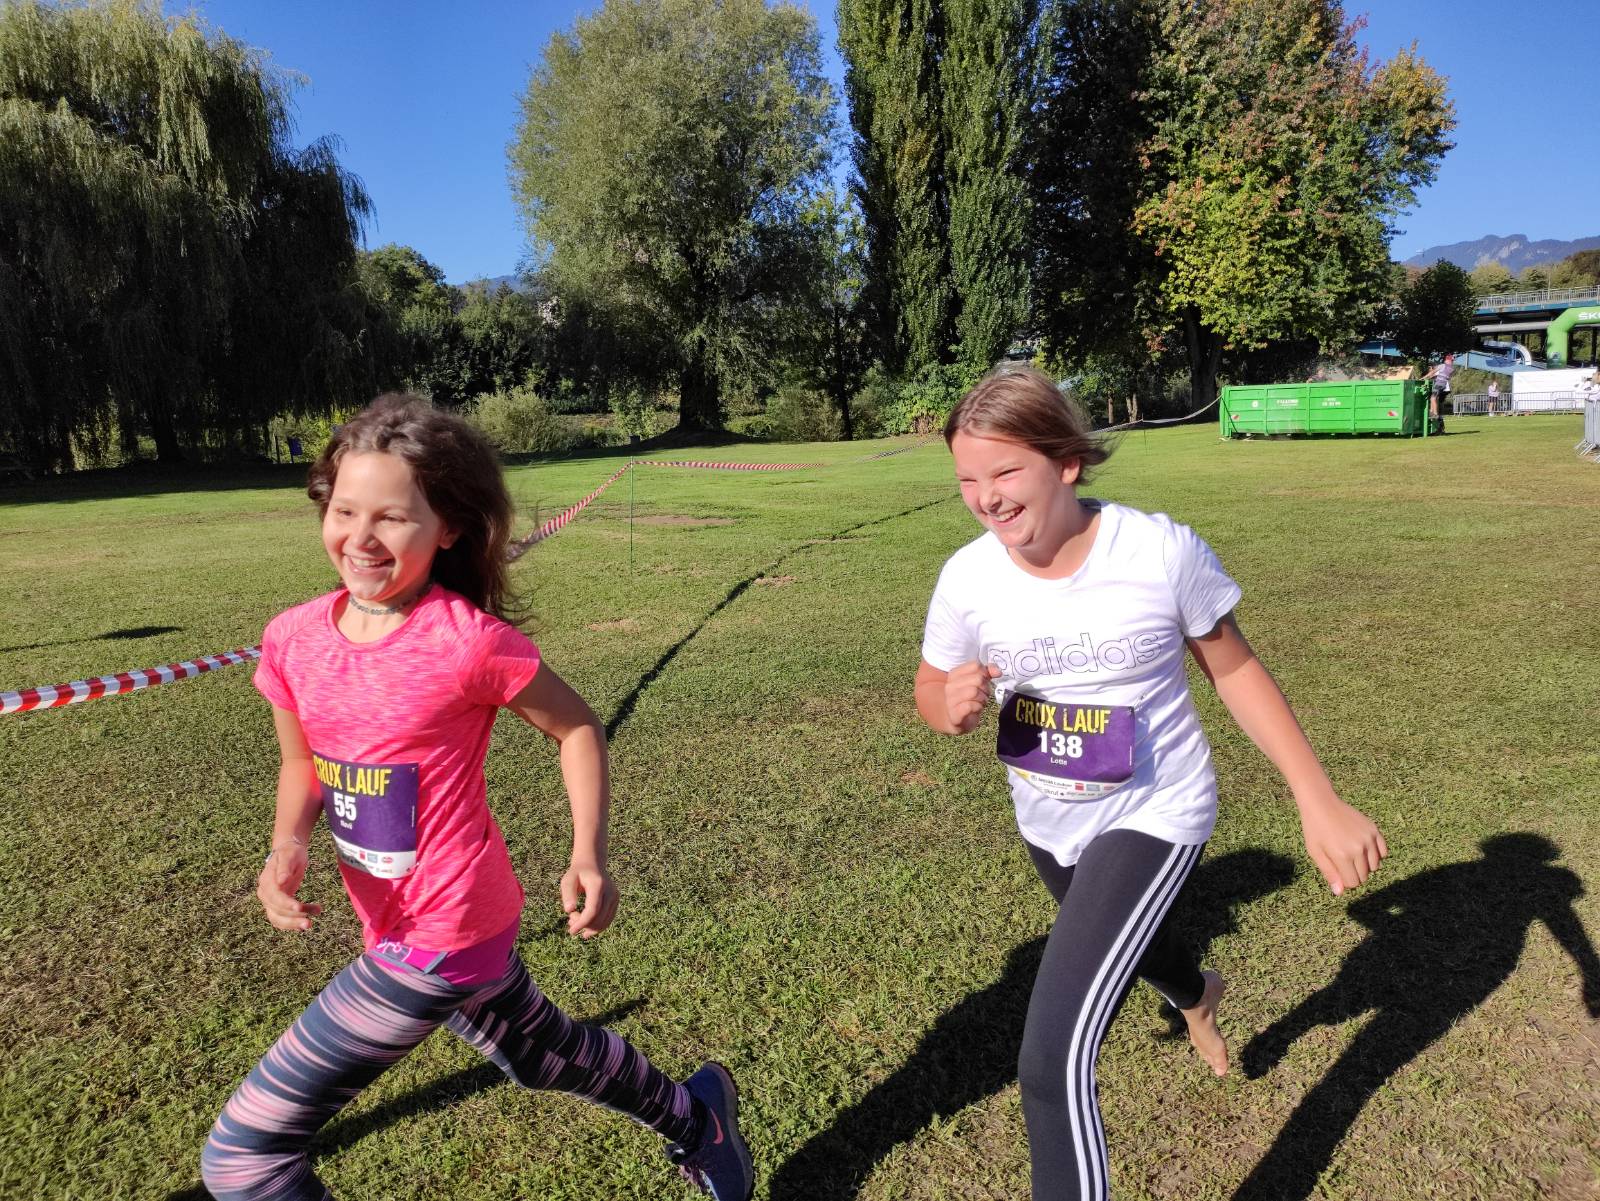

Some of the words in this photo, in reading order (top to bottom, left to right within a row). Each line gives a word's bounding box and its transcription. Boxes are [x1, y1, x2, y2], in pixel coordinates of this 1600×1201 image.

[1578, 311, 1600, 320] SK
[988, 632, 1162, 679] adidas
[1015, 698, 1057, 730] CRUX
[1063, 707, 1111, 734] LAUF
[1038, 730, 1083, 758] 138
[313, 754, 343, 790] CRUX
[346, 766, 392, 796] LAUF
[333, 791, 357, 821] 55
